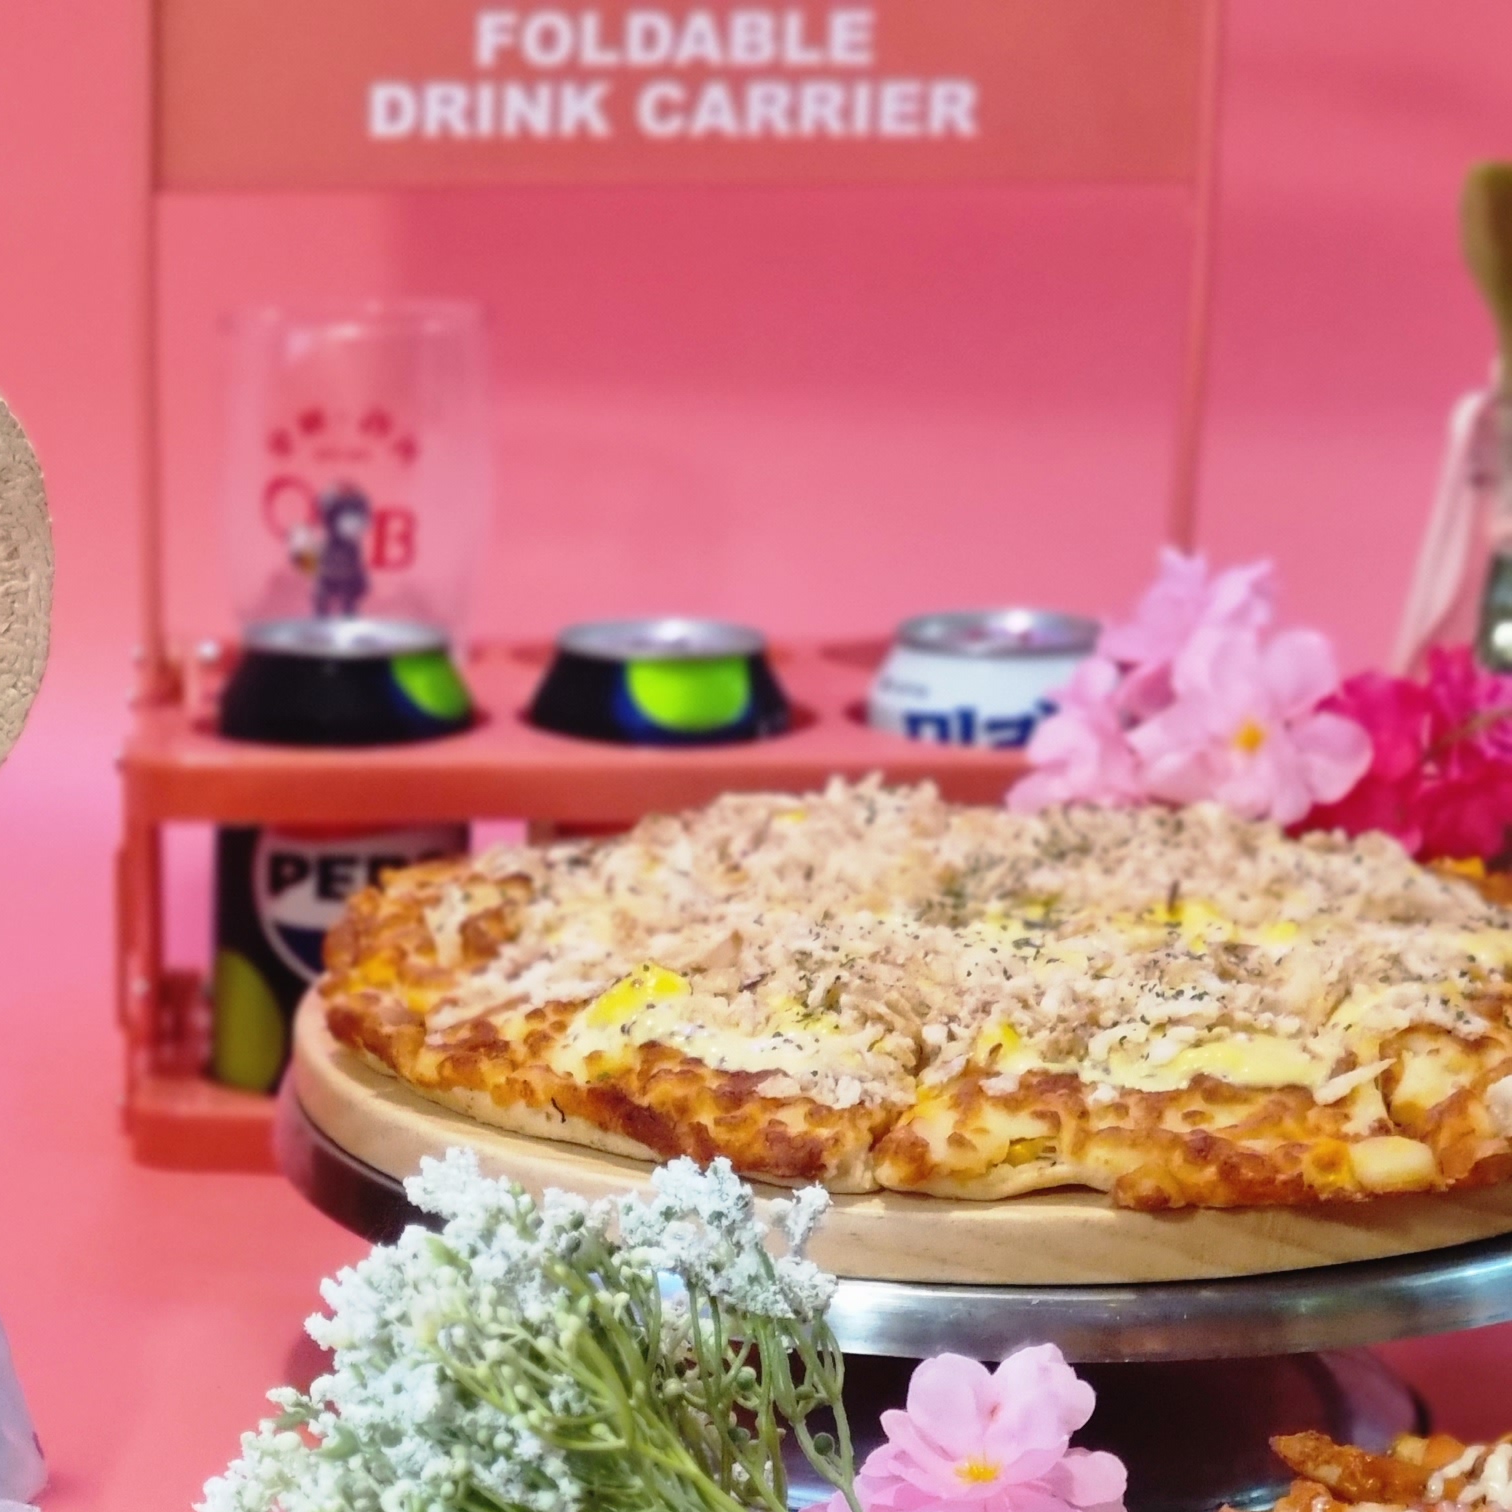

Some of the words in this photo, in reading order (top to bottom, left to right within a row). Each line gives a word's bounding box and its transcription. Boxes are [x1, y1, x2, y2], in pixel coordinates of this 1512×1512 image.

[475, 6, 877, 69] FOLDABLE
[367, 81, 612, 140] DRINK
[635, 80, 981, 140] CARRIER
